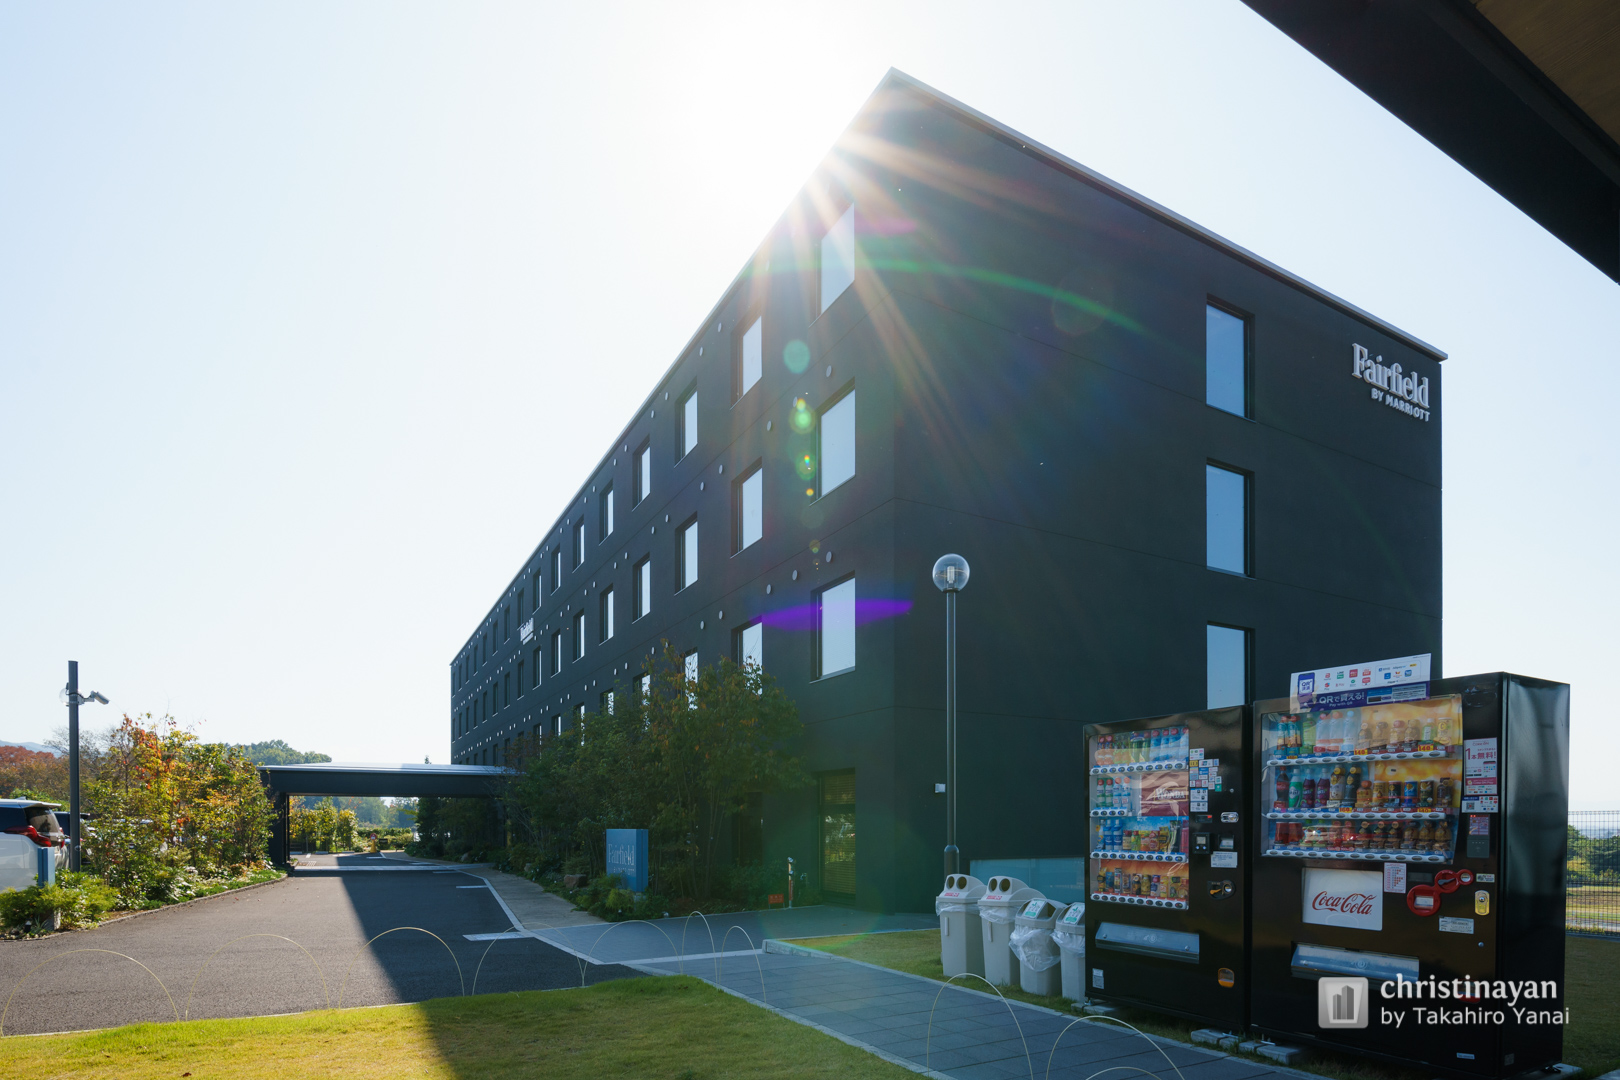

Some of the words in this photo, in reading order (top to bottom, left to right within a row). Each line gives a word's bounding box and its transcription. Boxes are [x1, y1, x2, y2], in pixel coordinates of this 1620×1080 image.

[1352, 343, 1430, 409] Fairfield
[1371, 388, 1384, 402] BY
[1385, 394, 1430, 422] MARRIOTT
[608, 844, 634, 866] Fairfield
[1312, 891, 1377, 915] Coca-Cola
